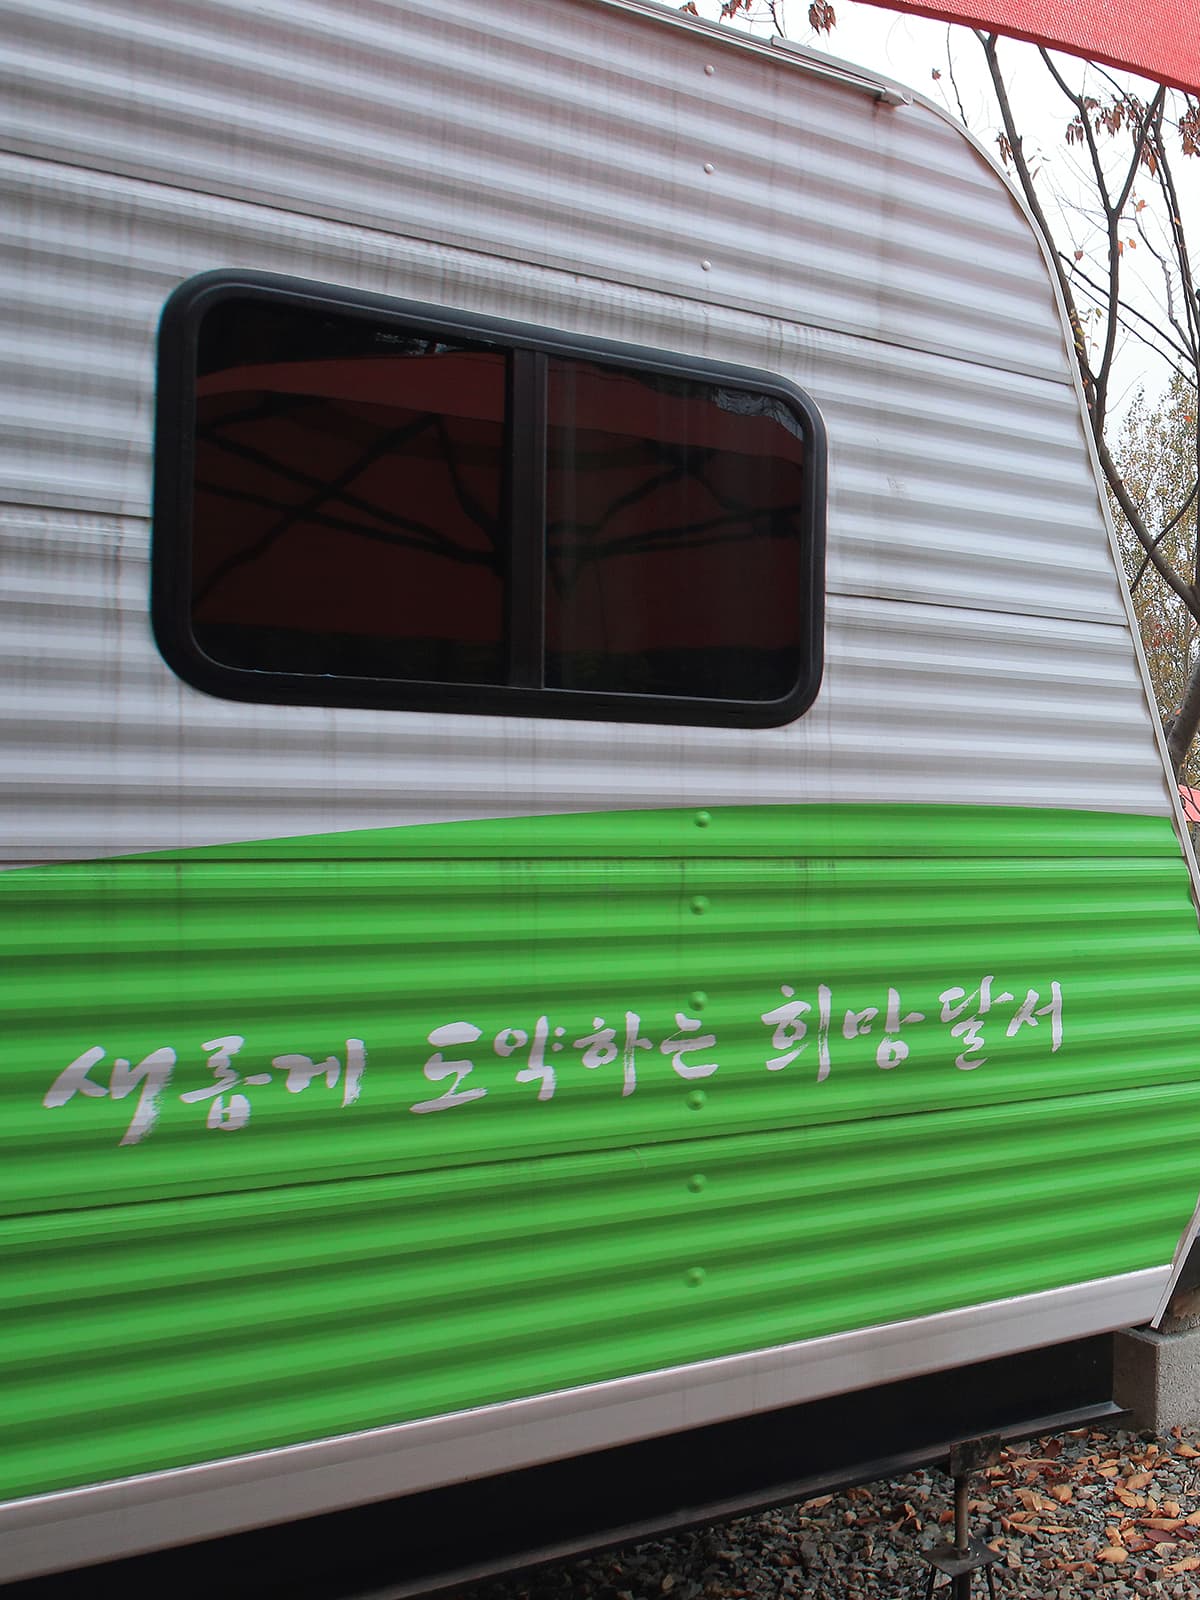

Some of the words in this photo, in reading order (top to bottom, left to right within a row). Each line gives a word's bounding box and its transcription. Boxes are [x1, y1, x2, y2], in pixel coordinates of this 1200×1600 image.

[409, 1011, 719, 1114] 도약하는
[761, 984, 926, 1083] 희망
[938, 975, 1063, 1071] 달서
